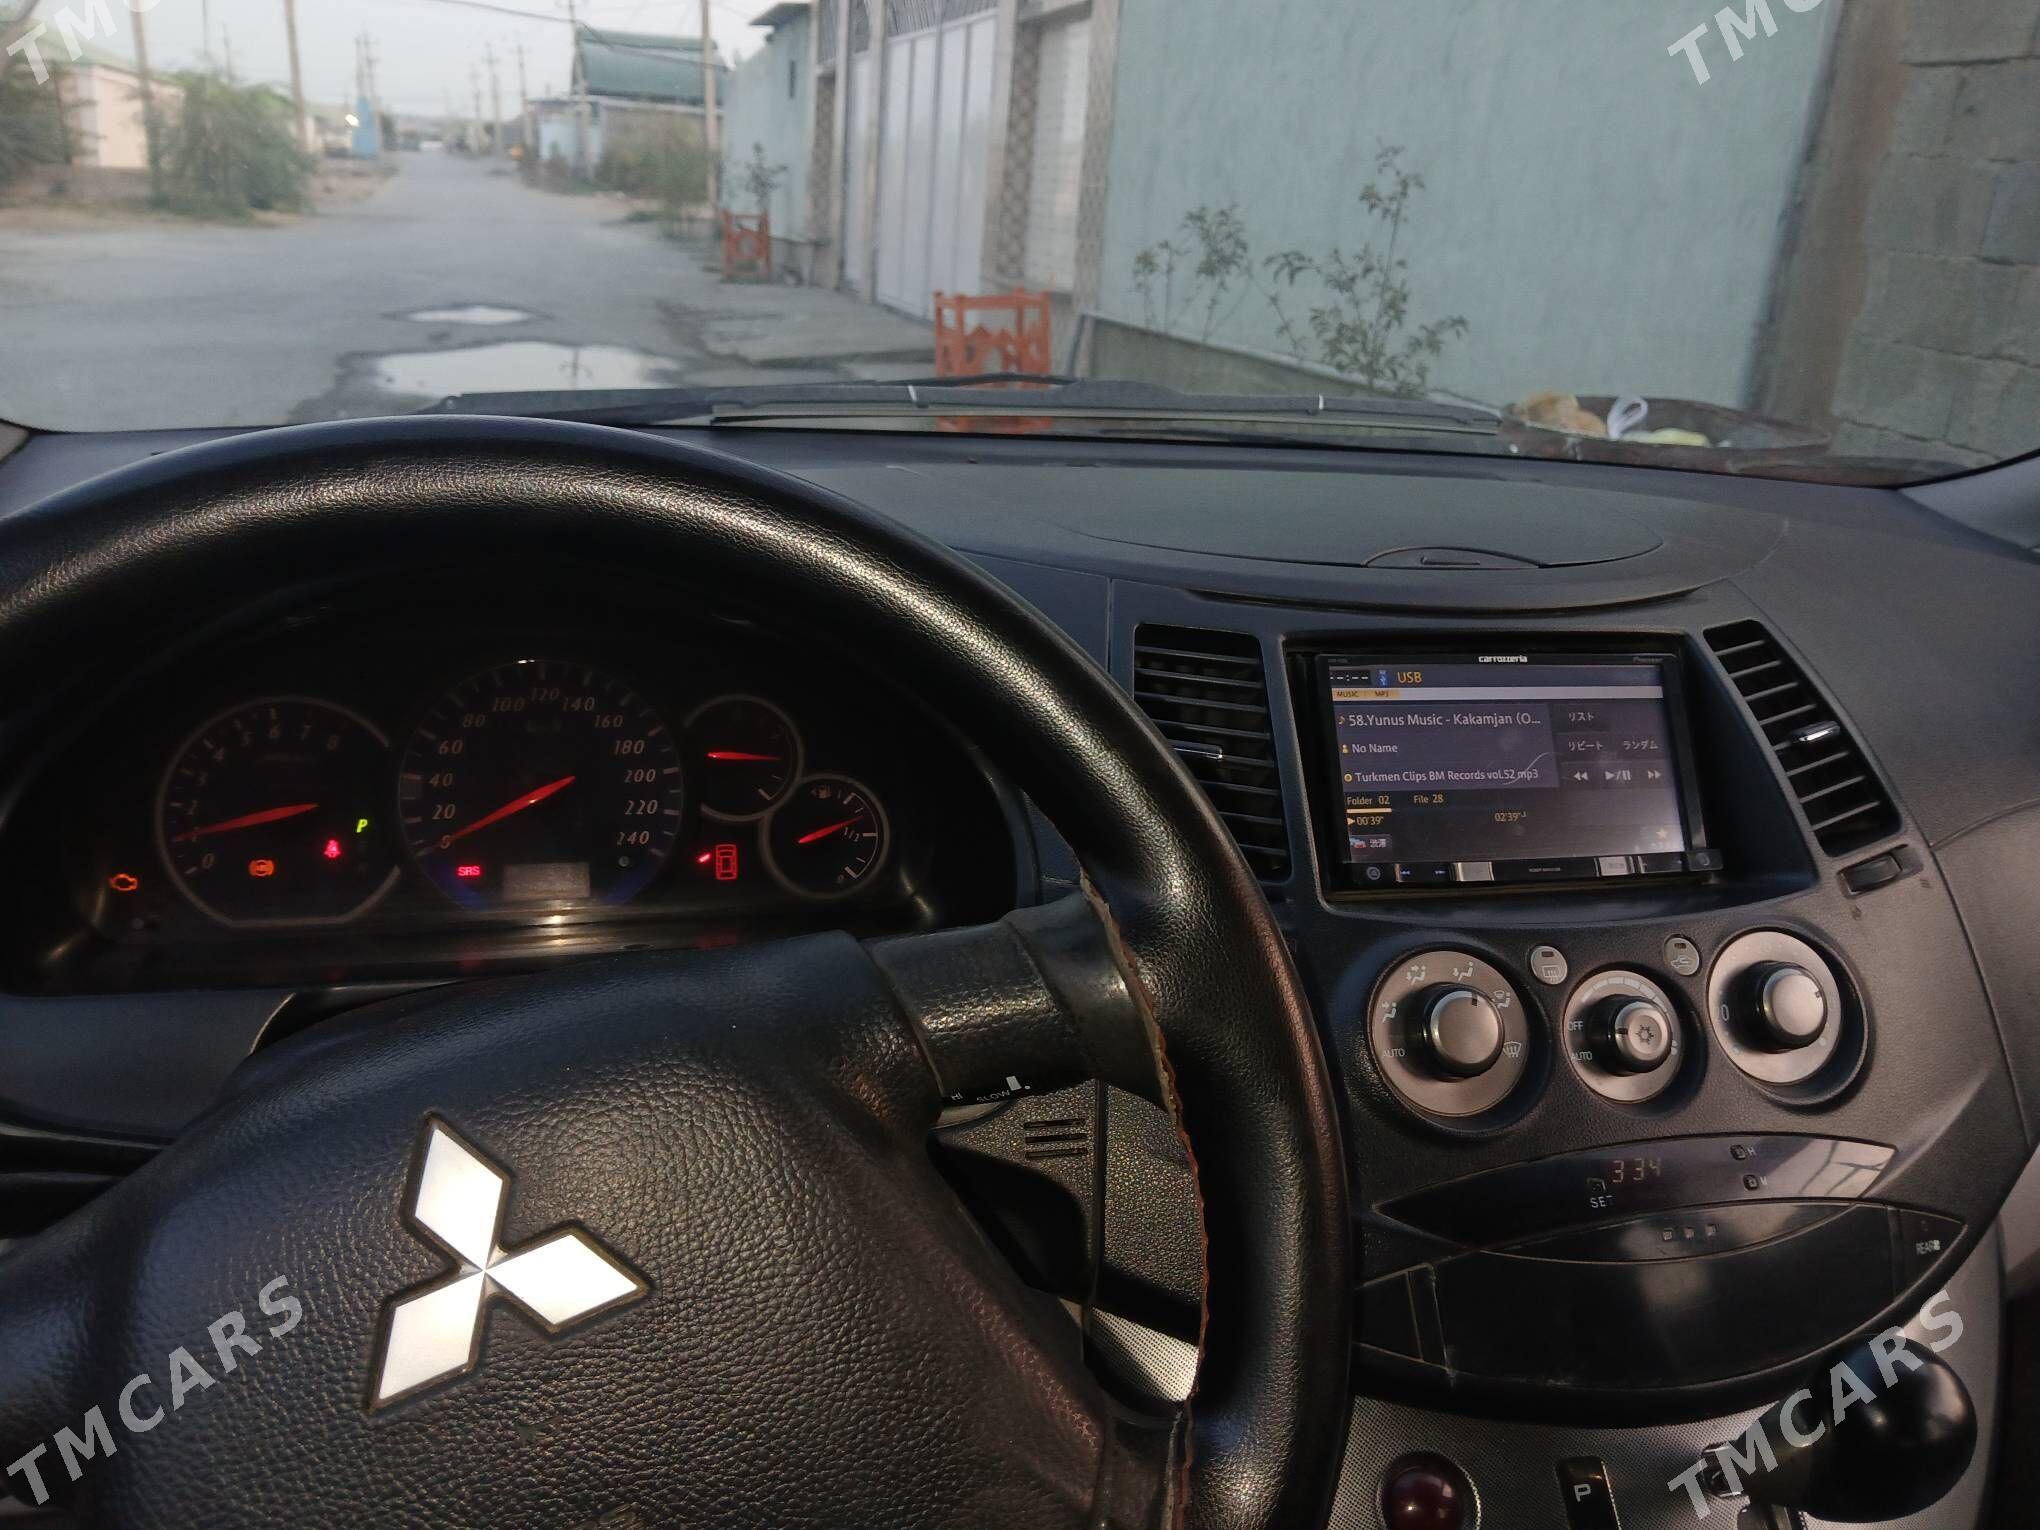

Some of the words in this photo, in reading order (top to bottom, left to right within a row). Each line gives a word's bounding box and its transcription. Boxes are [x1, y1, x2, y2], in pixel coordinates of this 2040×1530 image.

[1478, 654, 1528, 663] carrozzeria
[1397, 671, 1423, 684] USB
[1336, 690, 1359, 698] MUSIC
[492, 696, 528, 712] 100
[562, 696, 596, 712] 140
[463, 713, 488, 728] 80
[593, 713, 625, 728] 160
[1349, 713, 1404, 727] 58.Yunus
[1407, 712, 1443, 726] Music
[1453, 712, 1513, 728] Kakamjan
[1567, 711, 1595, 723] リスト
[439, 739, 465, 755] 60
[613, 739, 646, 755] 180
[1351, 743, 1367, 754] No
[1369, 743, 1398, 753] Name
[429, 772, 455, 788] 40
[624, 769, 657, 784] 200
[1354, 772, 1401, 782] Turkmen
[1402, 771, 1427, 783] Clips
[1448, 770, 1486, 780] Records
[1346, 796, 1373, 805] Folder
[1378, 795, 1390, 805] 02
[1413, 794, 1429, 804] File
[1432, 793, 1444, 804] 28
[432, 803, 456, 820] 20
[624, 800, 658, 815] 220
[355, 818, 368, 834] P
[617, 830, 650, 846] 240
[457, 866, 481, 877] SRS
[1567, 1021, 1584, 1032] OFF
[1382, 1048, 1406, 1058] AUTO
[1570, 1051, 1593, 1061] AUTO
[1573, 1483, 1592, 1503] P
